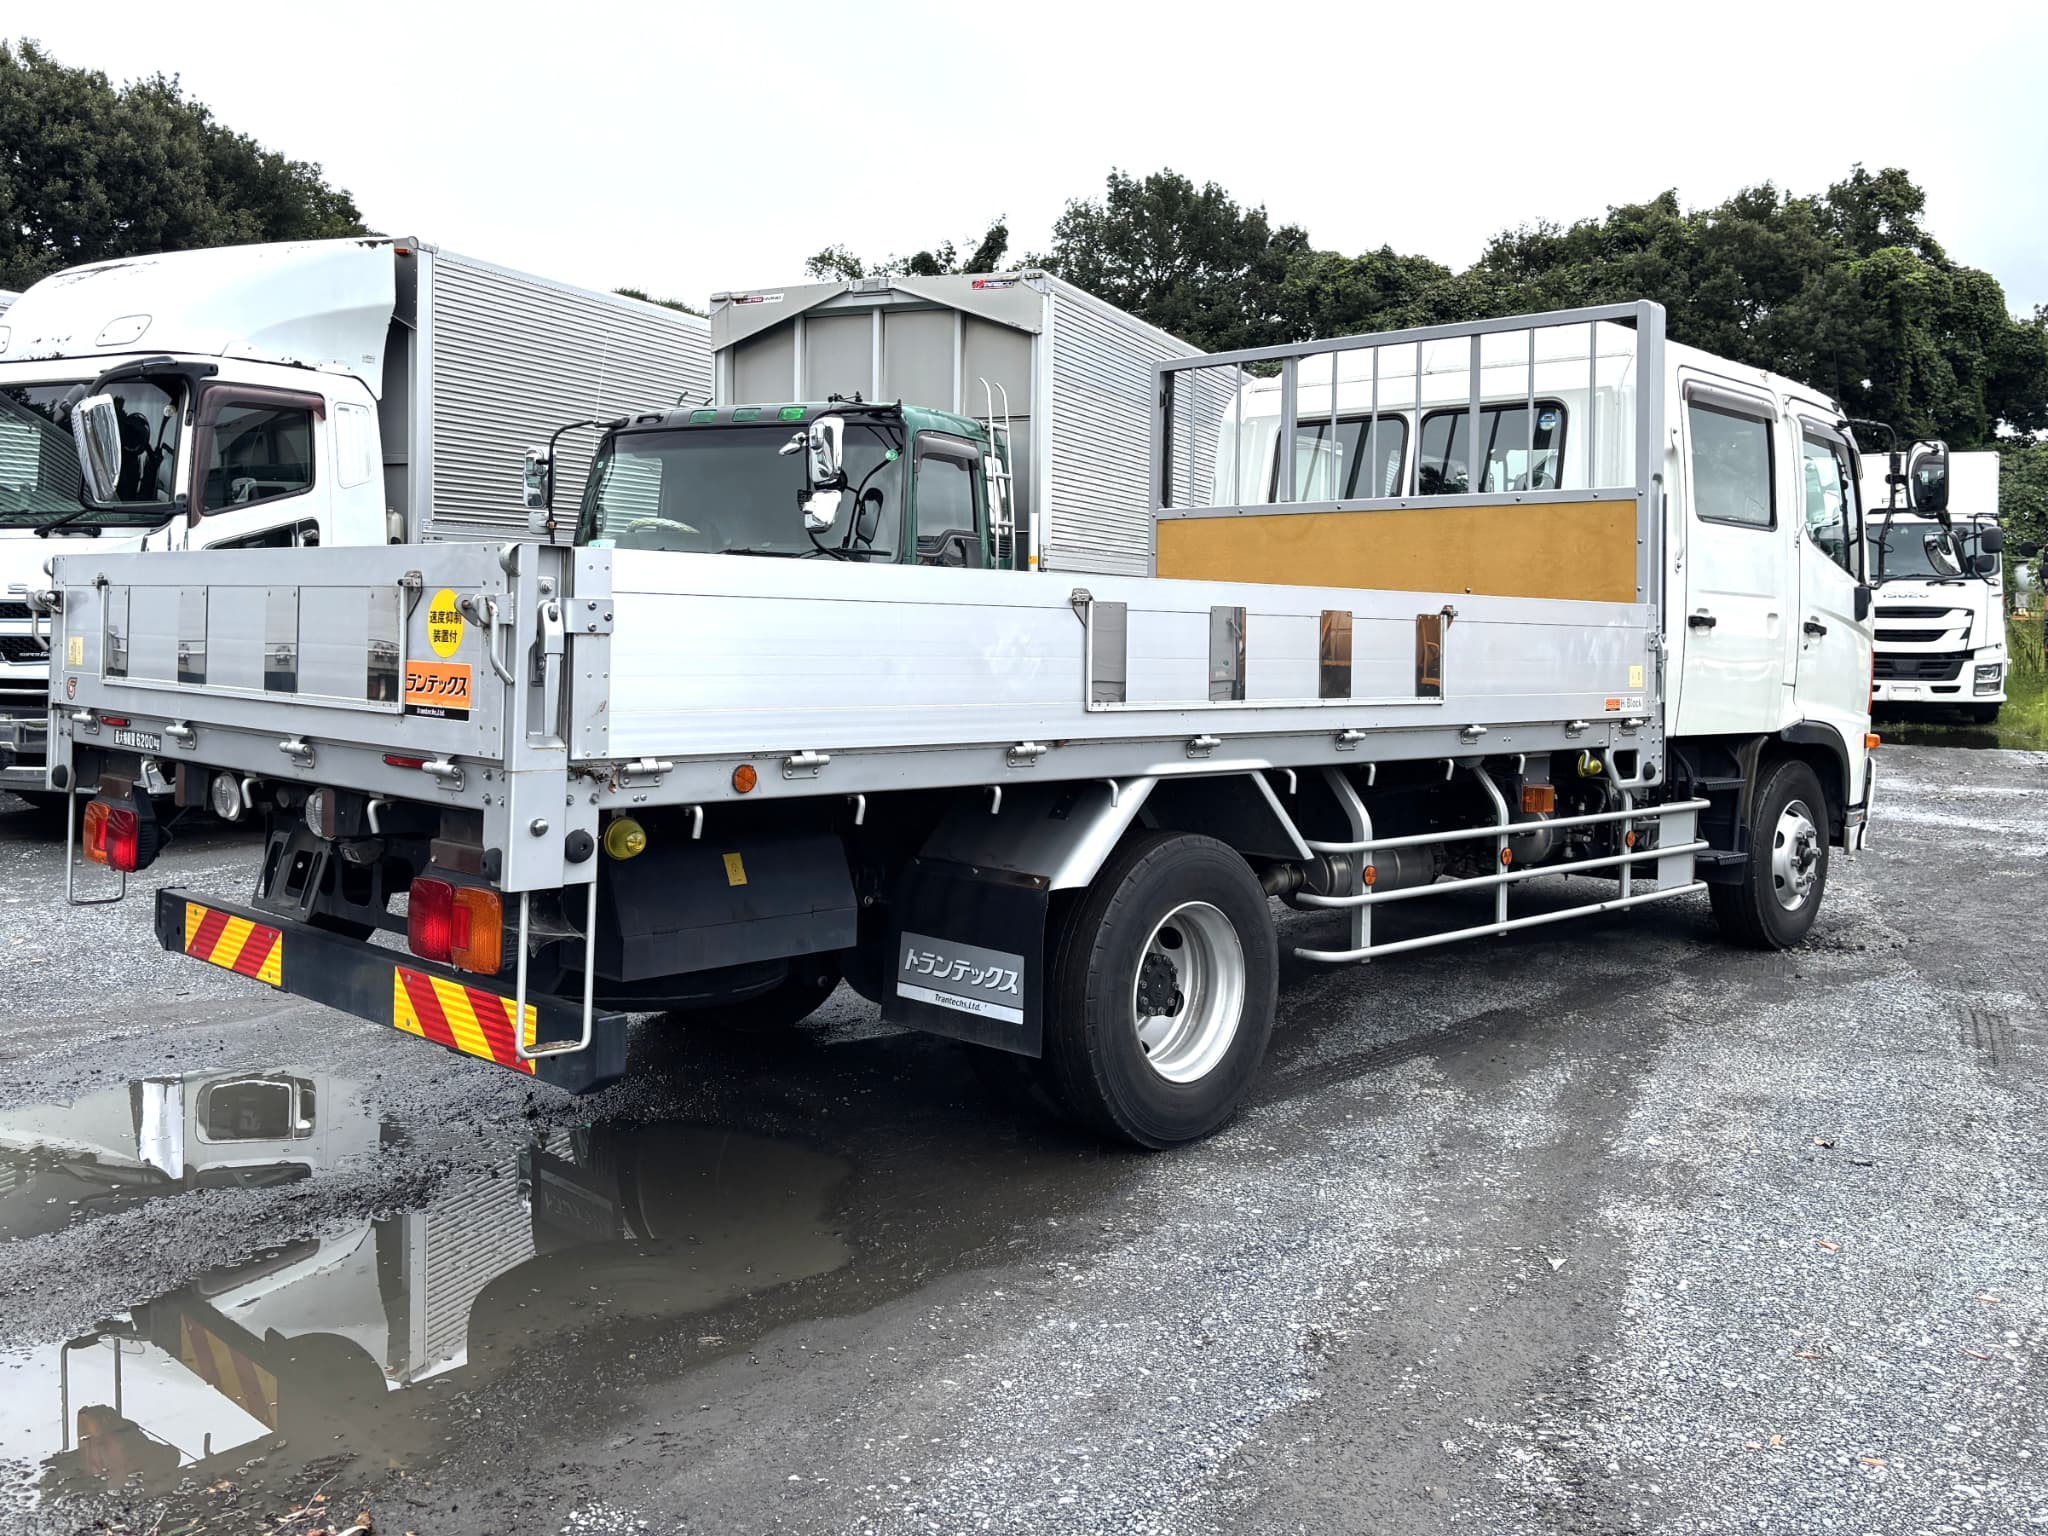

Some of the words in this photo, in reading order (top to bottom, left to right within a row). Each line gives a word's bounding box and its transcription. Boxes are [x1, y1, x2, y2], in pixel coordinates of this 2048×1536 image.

[433, 629, 458, 643] 装置付
[406, 673, 467, 697] ランテックス
[904, 948, 1019, 995] トランテックス
